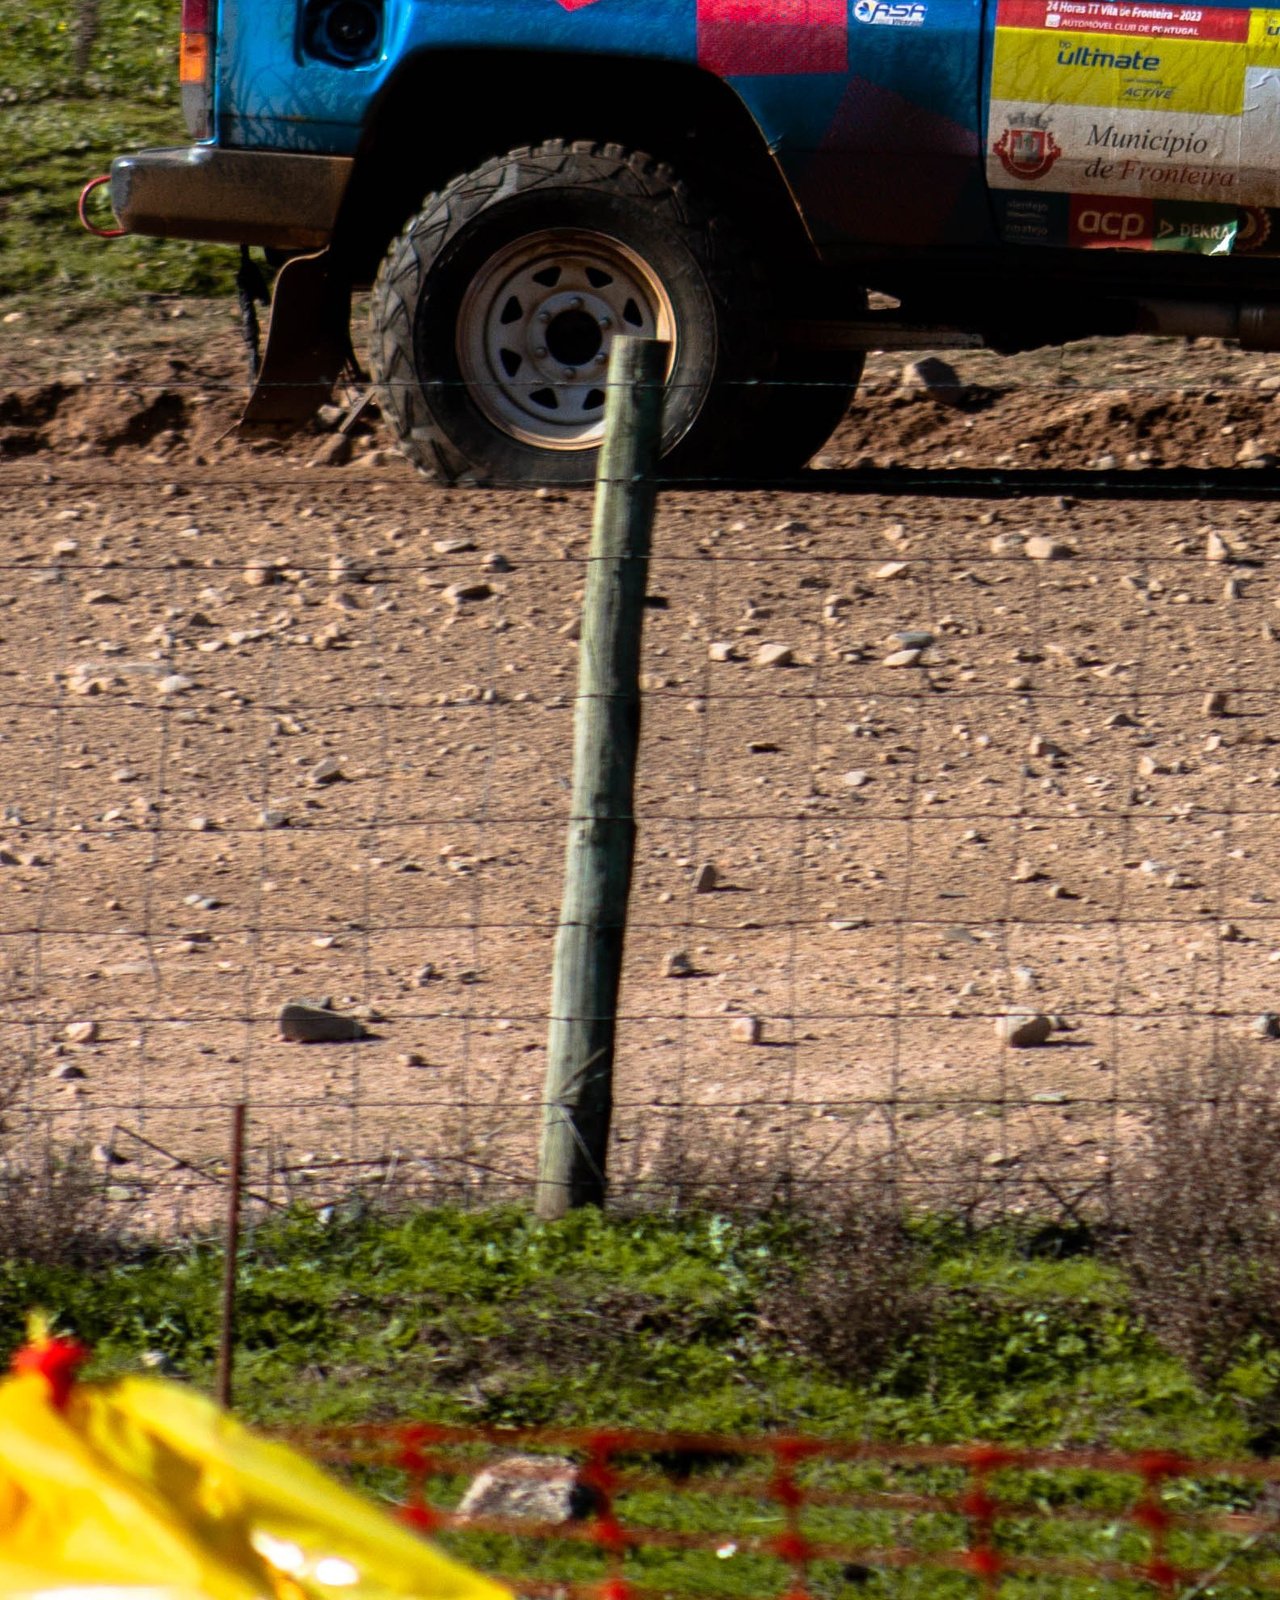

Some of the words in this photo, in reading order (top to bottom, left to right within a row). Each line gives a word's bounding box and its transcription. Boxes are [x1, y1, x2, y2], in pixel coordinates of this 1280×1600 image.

[870, 2, 928, 22] ASA
[1046, 0, 1058, 12] 24
[1059, 2, 1086, 14] Horas
[1088, 4, 1100, 14] TT
[1101, 4, 1118, 16] Vila
[1132, 8, 1172, 20] Fronteira
[1180, 10, 1202, 22] 2023
[1061, 18, 1114, 30] AUTOMÓVEL
[1114, 22, 1136, 31] CLUB
[1138, 24, 1149, 32] DE
[1151, 26, 1199, 36] PORTUGAL
[1057, 47, 1160, 71] ultimate
[1123, 87, 1175, 99] ACTIVE
[1085, 122, 1208, 156] Município
[1085, 159, 1114, 180] de
[1117, 158, 1237, 189] Fronteira
[1077, 210, 1145, 240] acp
[1180, 222, 1233, 240] DEKRA
